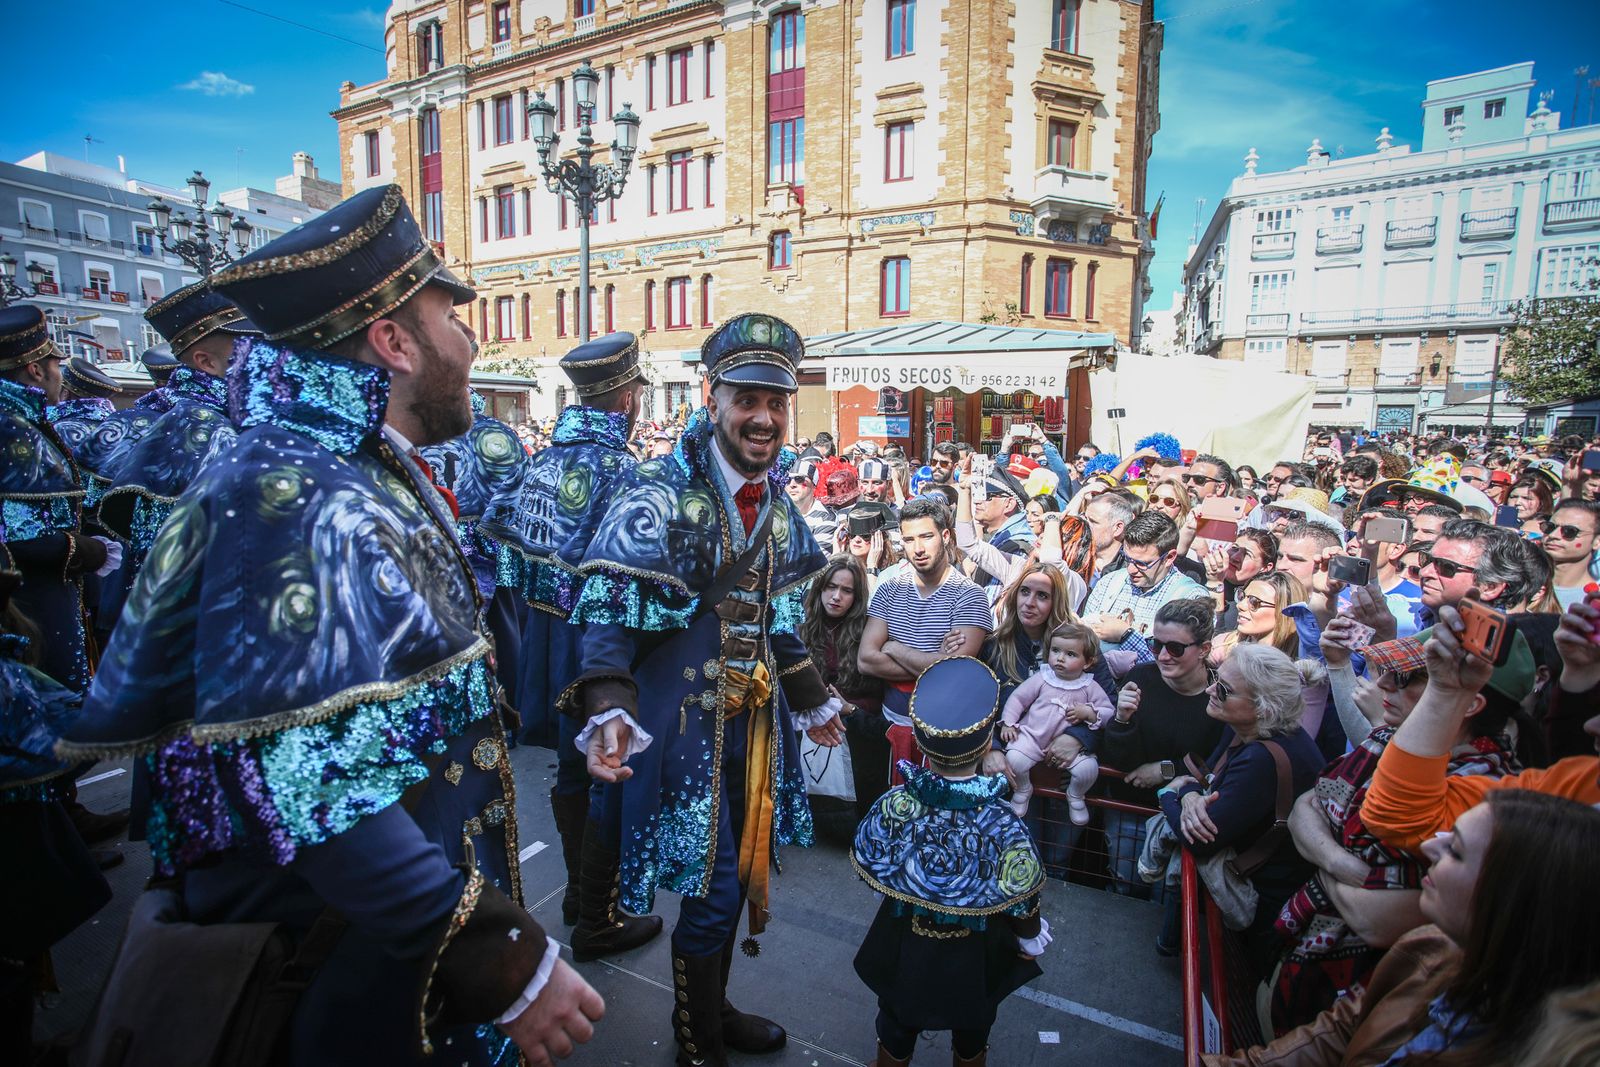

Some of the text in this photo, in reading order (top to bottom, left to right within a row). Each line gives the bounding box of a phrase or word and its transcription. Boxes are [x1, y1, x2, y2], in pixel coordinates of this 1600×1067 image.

[833, 367, 952, 385] FRUTOS SECOS
[981, 375, 1002, 386] 956
[1005, 375, 1020, 387] 22
[1024, 376, 1035, 387] 31
[1040, 376, 1056, 388] 42
